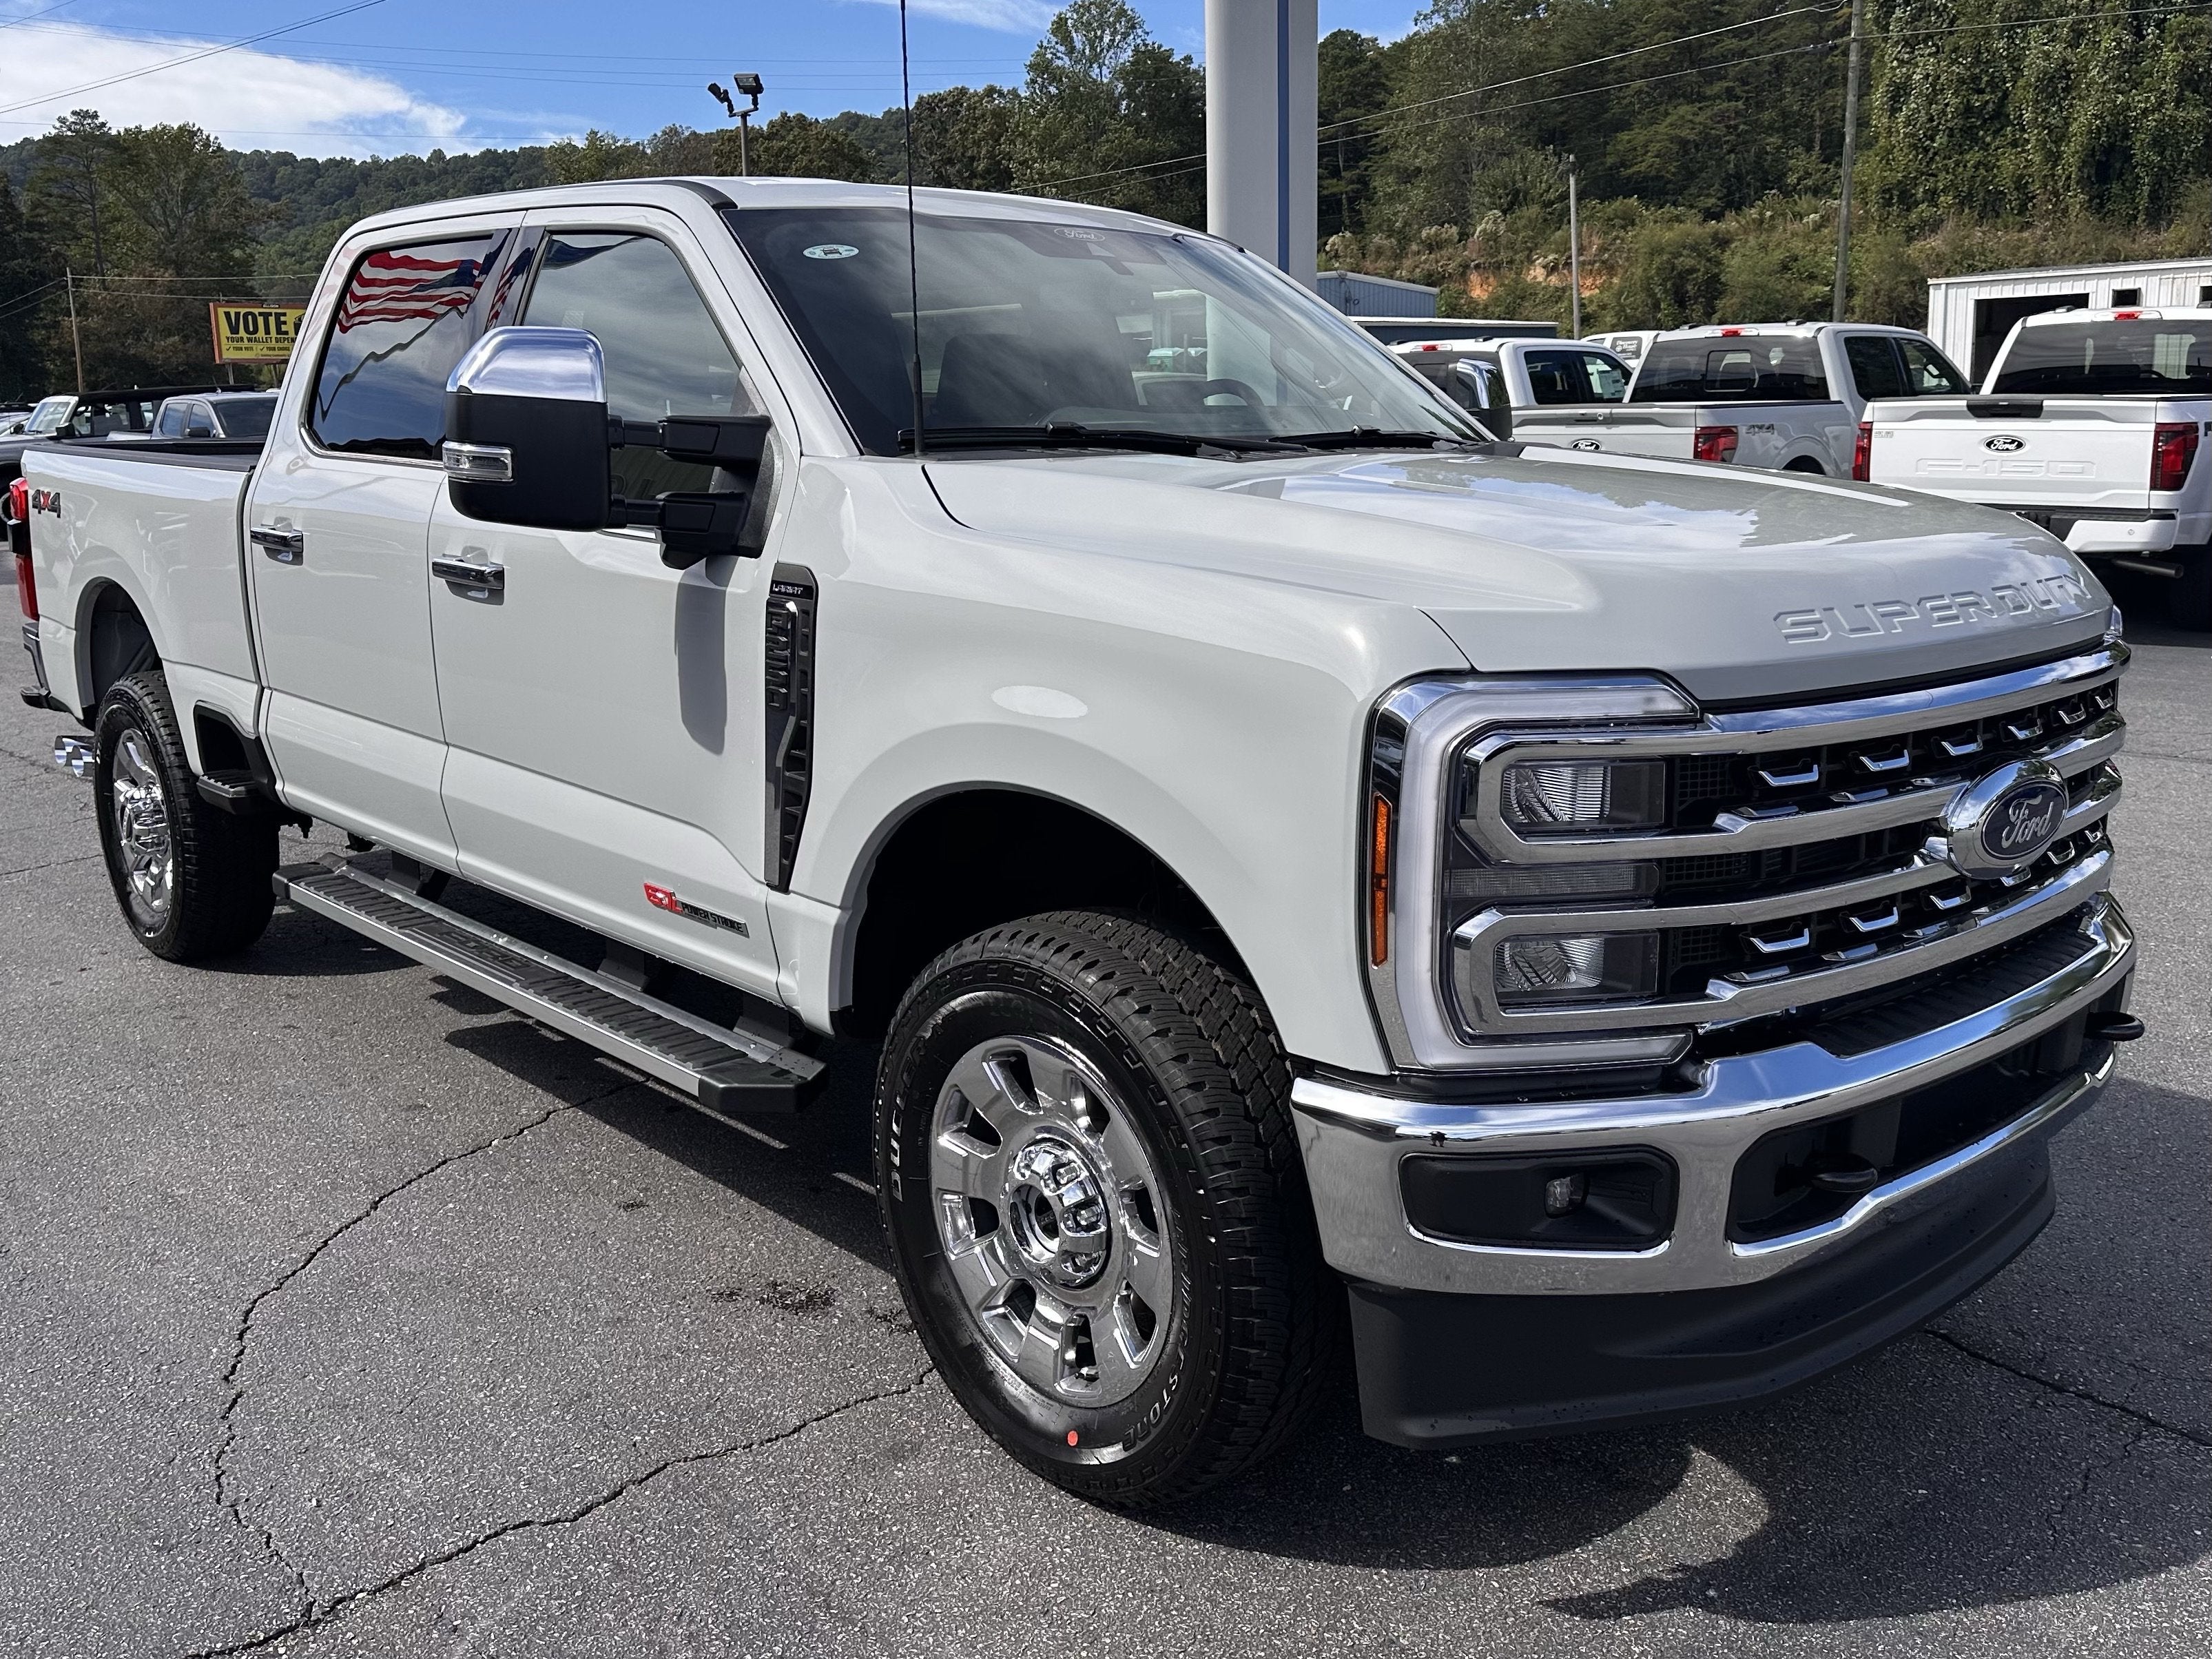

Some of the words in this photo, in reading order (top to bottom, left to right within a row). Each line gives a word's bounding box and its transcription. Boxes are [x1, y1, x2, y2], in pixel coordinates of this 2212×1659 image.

[223, 311, 289, 336] VOTE
[1576, 442, 1597, 450] Ford
[1989, 438, 2020, 451] Ford
[1916, 457, 2096, 479] F-150
[772, 583, 803, 595] LARIAT
[1773, 590, 1998, 644] SUPER
[1991, 570, 2092, 615] DUTY
[2001, 794, 2054, 849] Ford
[681, 901, 710, 921] POWER
[711, 914, 744, 933] STROKE
